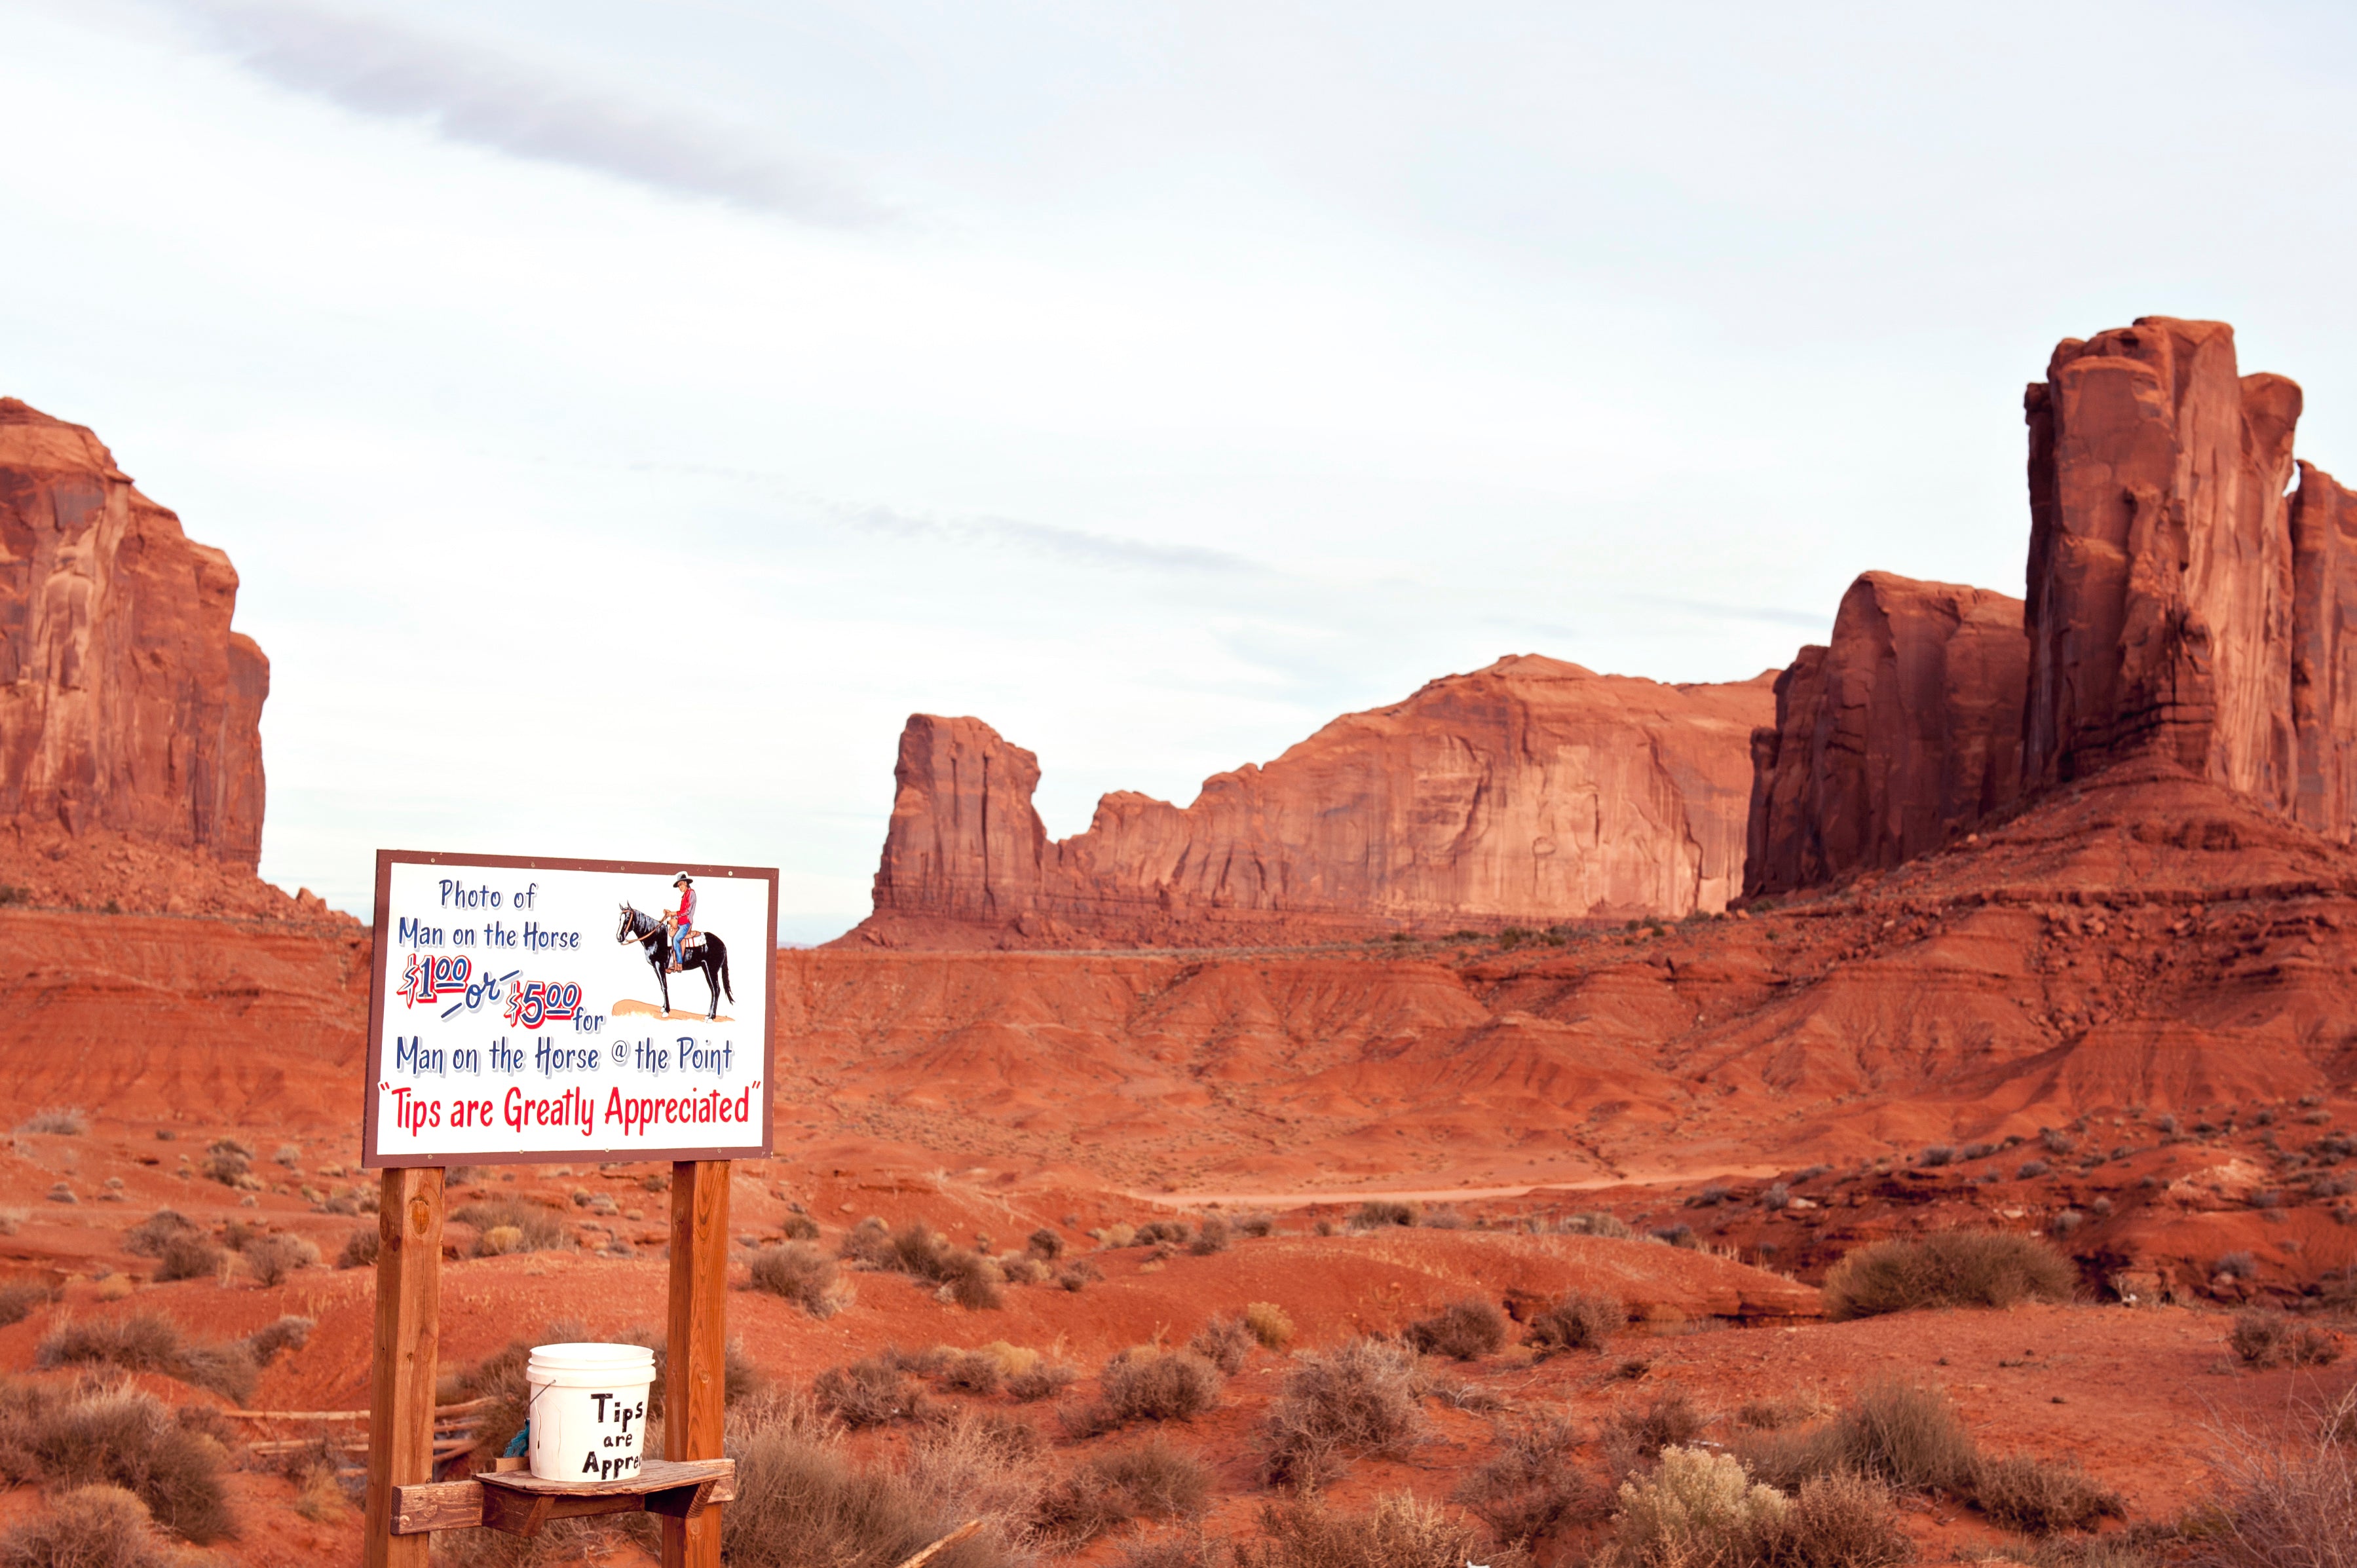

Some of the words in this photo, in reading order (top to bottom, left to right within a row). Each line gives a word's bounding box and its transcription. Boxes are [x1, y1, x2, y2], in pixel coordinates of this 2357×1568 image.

[439, 879, 501, 908] Photo
[514, 883, 537, 908] of
[399, 917, 443, 948] Man
[453, 928, 475, 945] on
[483, 920, 516, 946] the
[523, 921, 580, 951] Horse
[573, 1007, 604, 1031] for
[396, 1036, 443, 1074] Man
[453, 1049, 477, 1073] on
[489, 1036, 523, 1073] the
[535, 1036, 599, 1075] Horse
[611, 1039, 628, 1062] @
[635, 1037, 668, 1073] the
[676, 1037, 732, 1075] Point
[451, 1100, 493, 1127] are
[504, 1086, 594, 1136] Greatly
[590, 1392, 643, 1433] Tips
[603, 1433, 633, 1448] are
